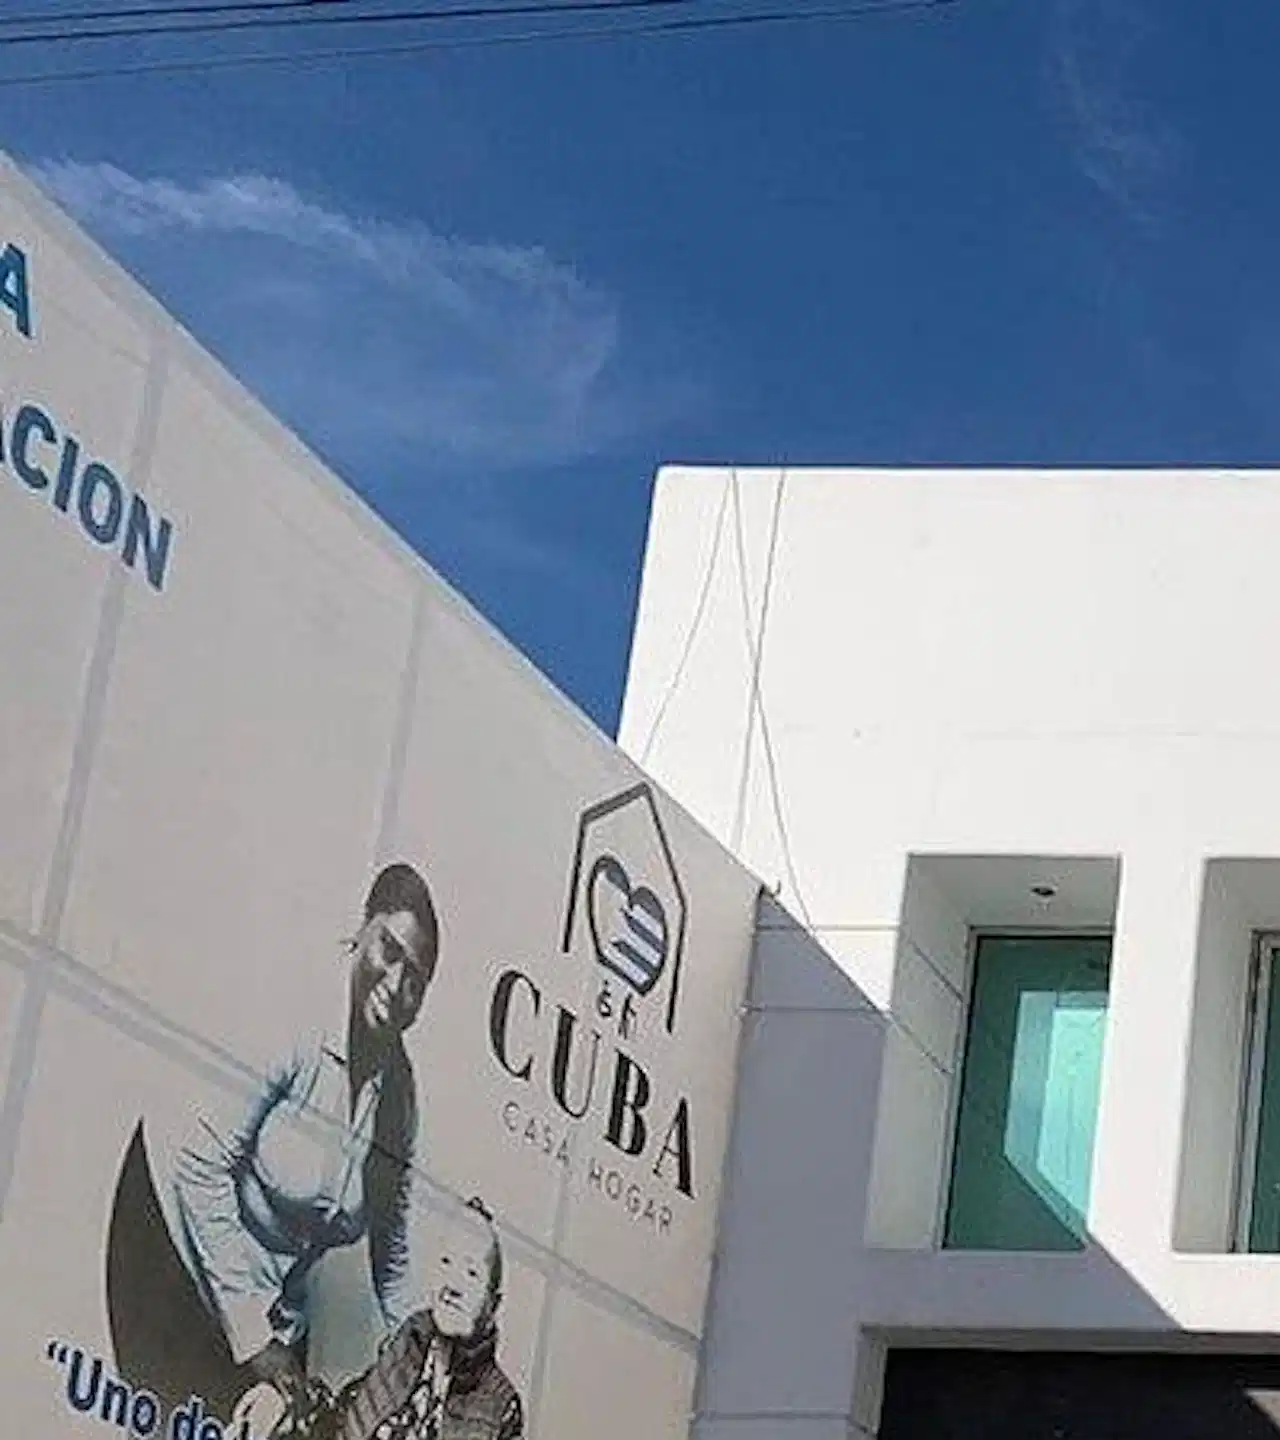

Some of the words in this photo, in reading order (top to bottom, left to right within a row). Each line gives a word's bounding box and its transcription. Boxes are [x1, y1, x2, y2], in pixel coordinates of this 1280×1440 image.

[0, 404, 172, 592] CION
[490, 969, 696, 1199] CUBA
[503, 1101, 570, 1167] CASA
[588, 1157, 672, 1236] HOGAR
